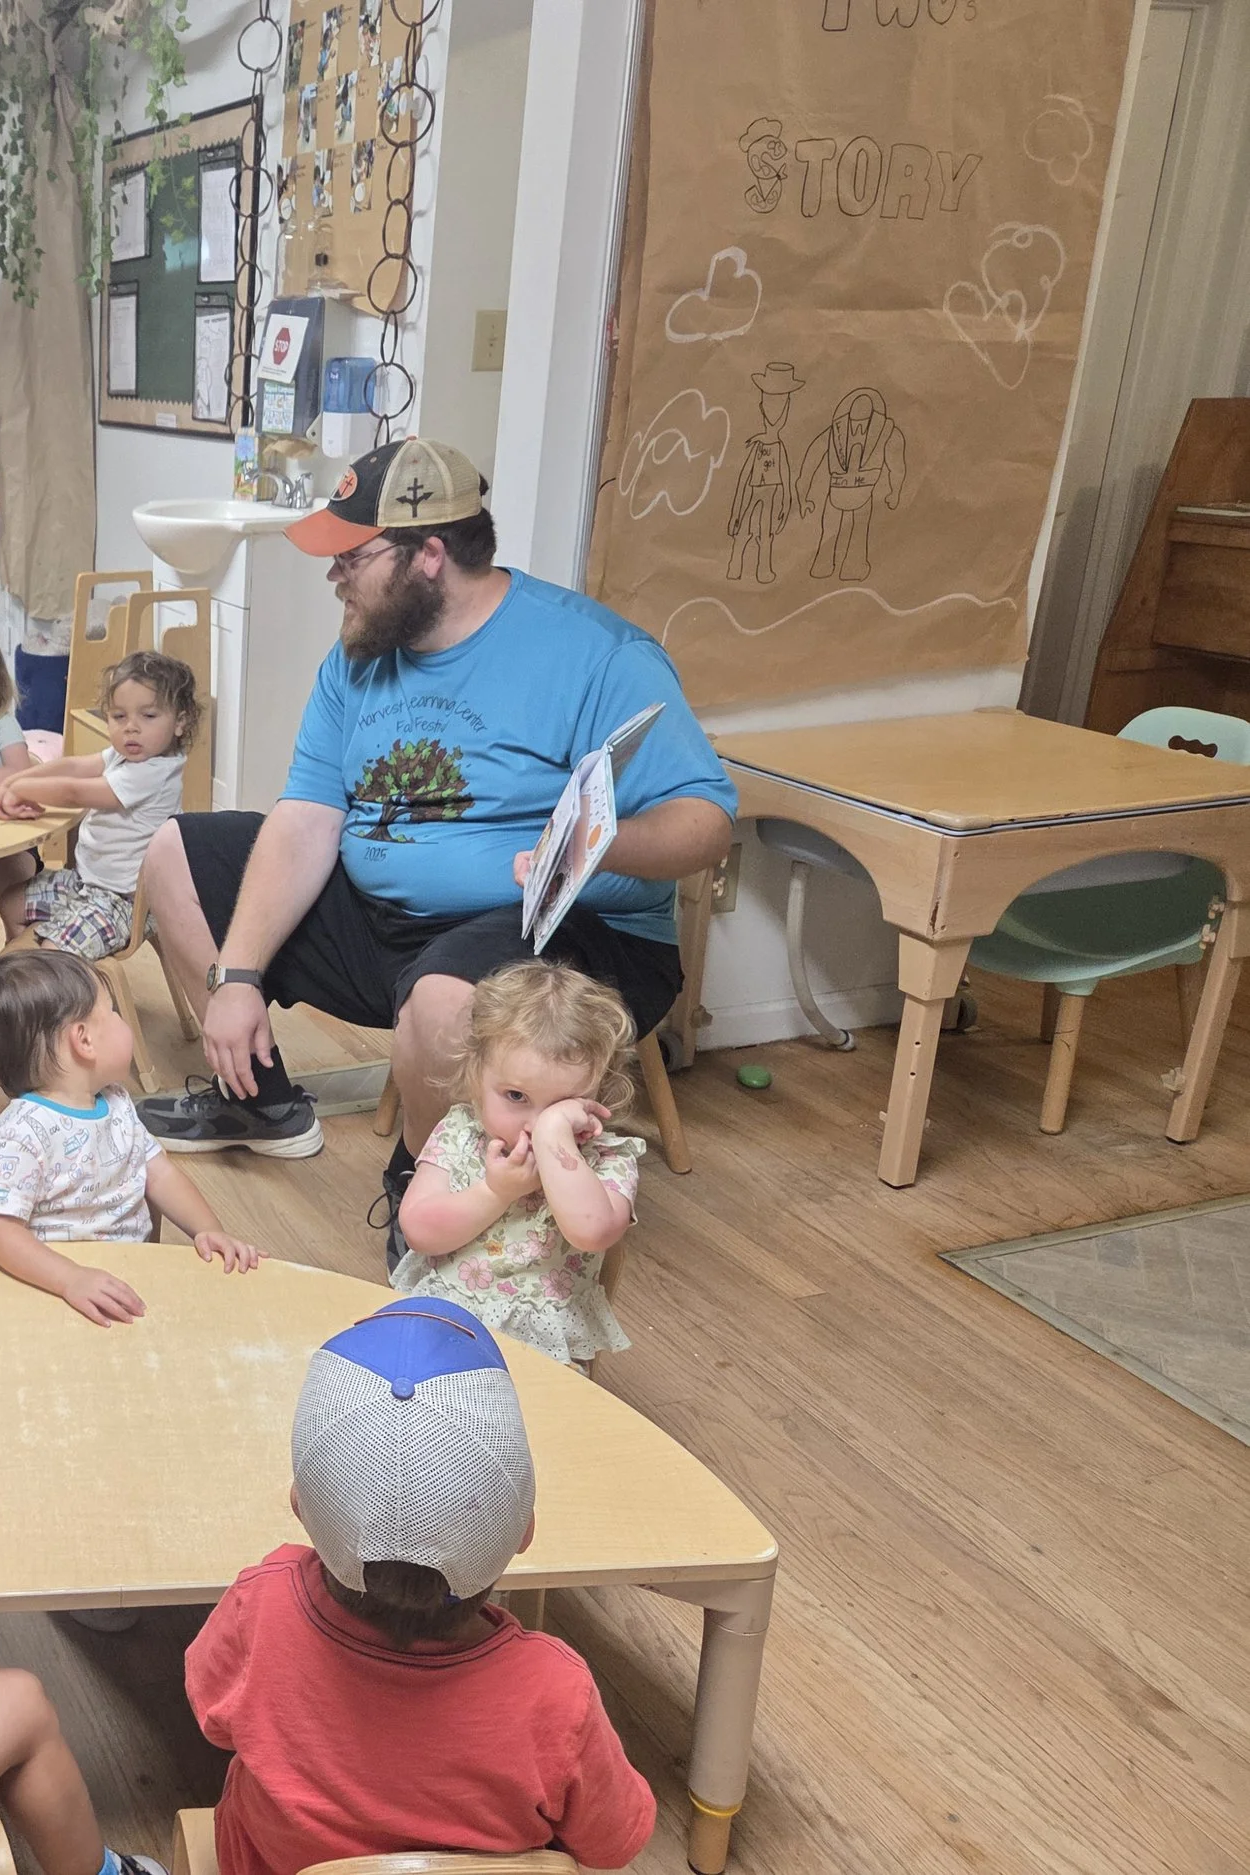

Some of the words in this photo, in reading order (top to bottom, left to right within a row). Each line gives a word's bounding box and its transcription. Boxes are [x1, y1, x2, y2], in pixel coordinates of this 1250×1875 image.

[740, 134, 982, 220] STORY
[274, 339, 289, 353] STOP
[763, 458, 775, 472] got
[357, 701, 406, 730] Harvest
[454, 700, 488, 732] Center
[364, 846, 388, 862] 2025
[81, 1184, 94, 1193] DIG
